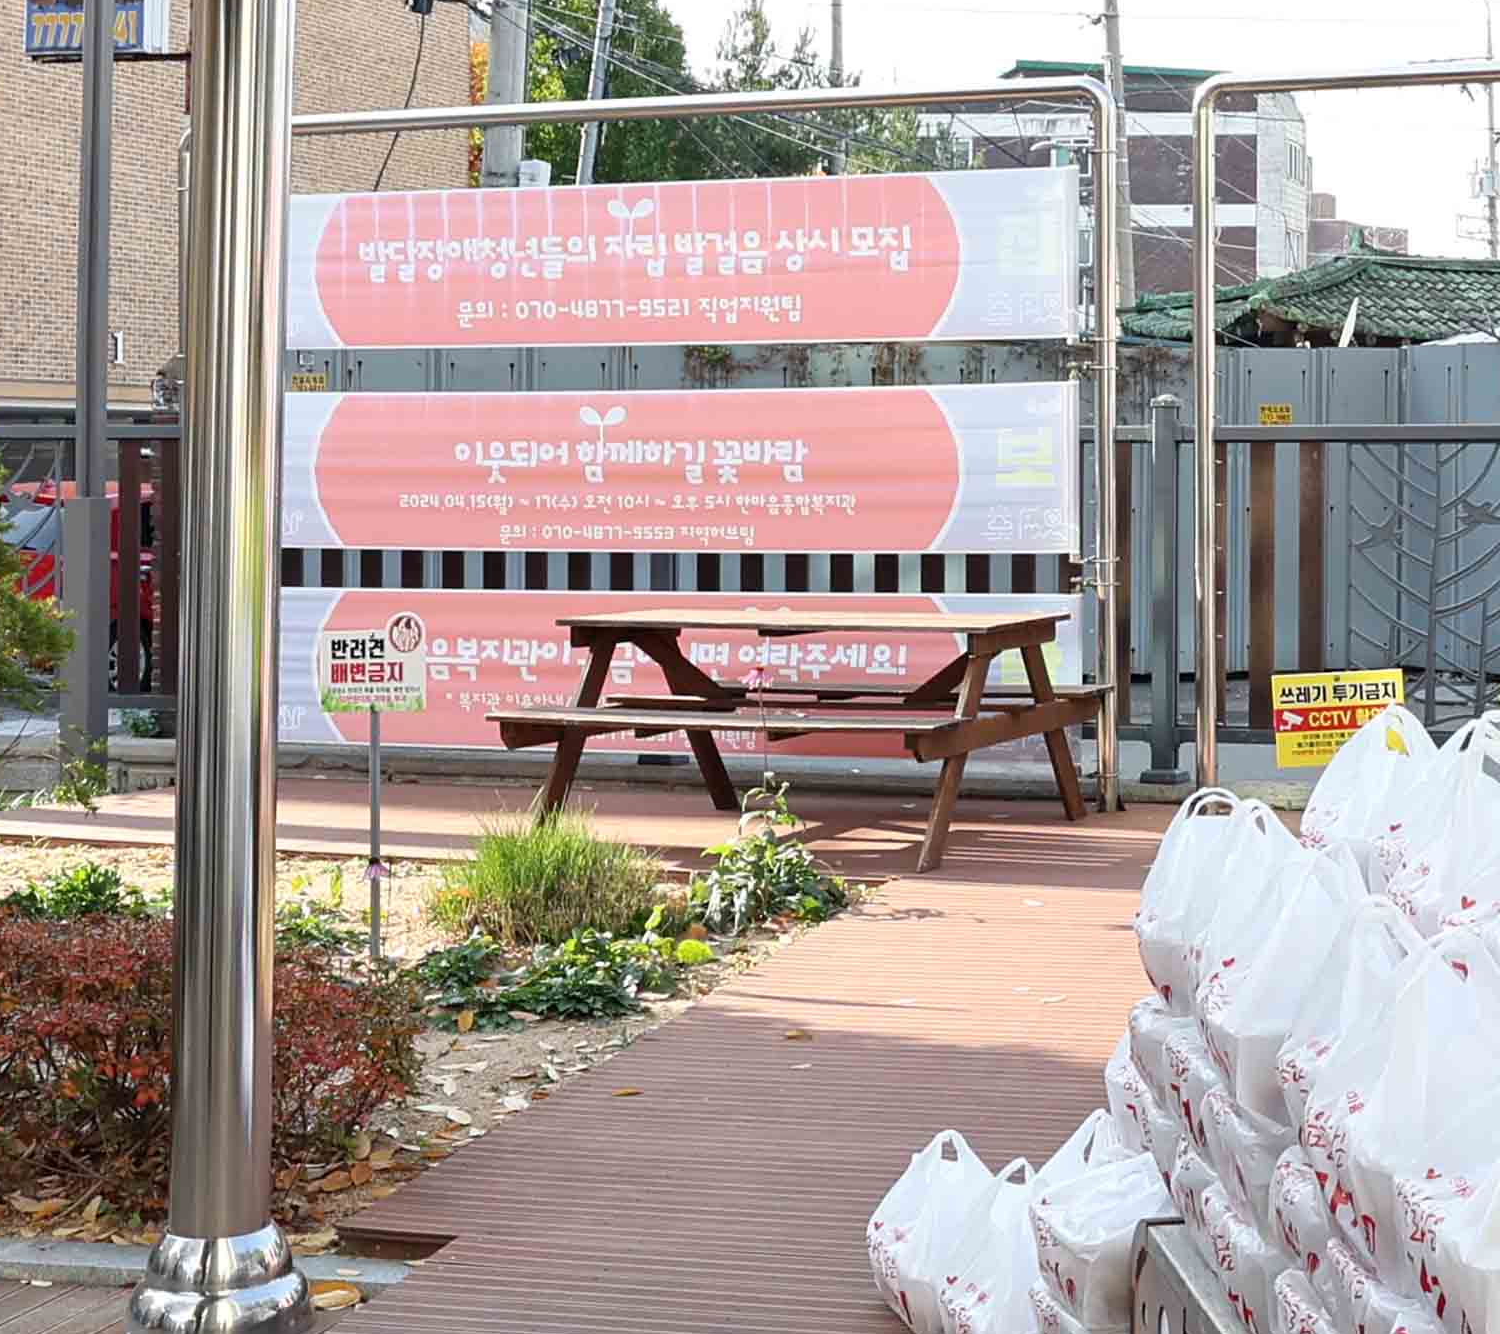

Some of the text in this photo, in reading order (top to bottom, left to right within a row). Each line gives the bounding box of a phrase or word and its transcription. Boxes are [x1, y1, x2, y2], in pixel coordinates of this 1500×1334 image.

[358, 224, 913, 283] 발달장애청년들의 자립 발걸음 상시 모집
[457, 300, 494, 328] 문의
[454, 440, 569, 484] 이웃되어
[575, 439, 705, 484] 함께하길
[331, 637, 385, 659] 반려견
[421, 637, 572, 682] 음복지관이
[331, 662, 404, 684] 배변금지
[1280, 681, 1397, 704] 쓰레기 투기금지
[1308, 711, 1351, 728] CCTV
